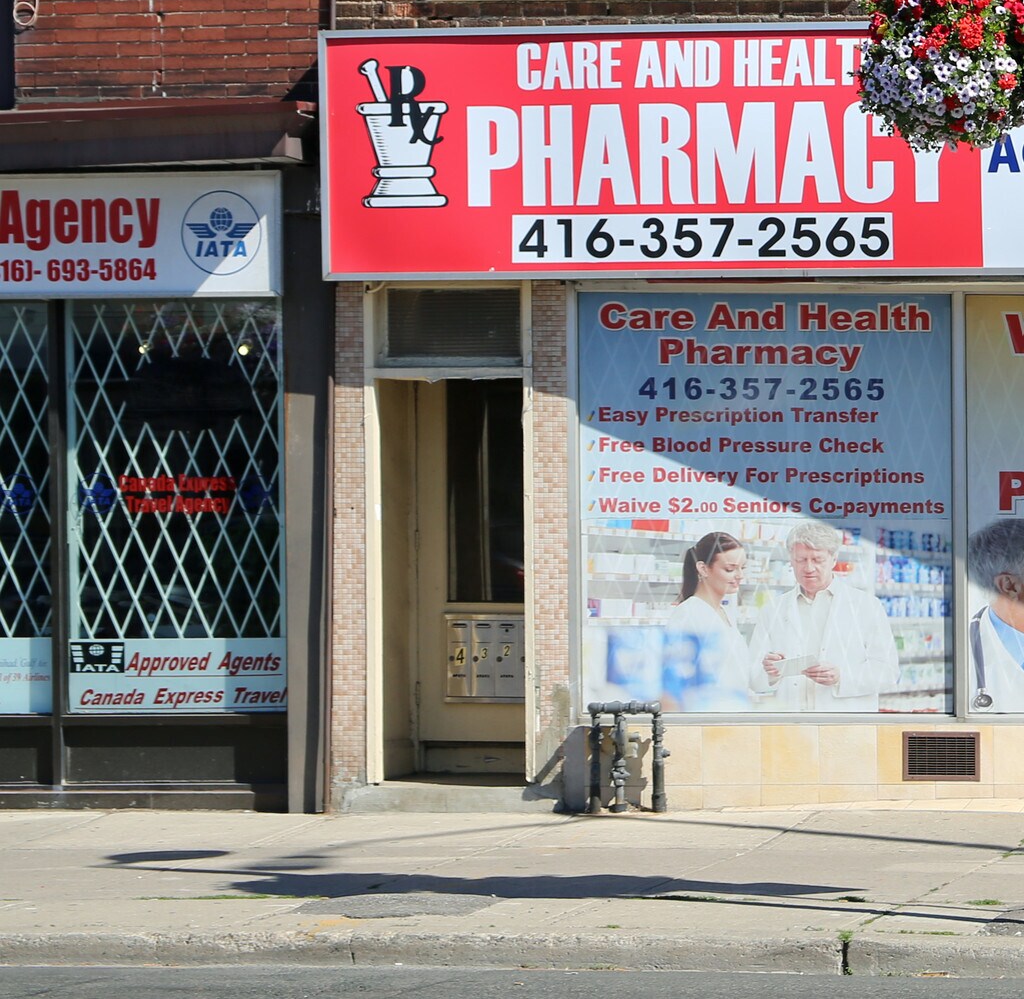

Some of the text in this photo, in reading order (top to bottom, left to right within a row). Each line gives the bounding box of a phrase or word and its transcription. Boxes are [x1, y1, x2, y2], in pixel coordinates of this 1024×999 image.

[517, 38, 871, 91] CARE AND HEALT
[466, 100, 944, 208] PHARMACY
[0, 190, 160, 252] Agency
[195, 240, 247, 258] IATA
[517, 215, 890, 260] 416-357-2565
[47, 258, 157, 282] 693-5864
[599, 302, 933, 331] Care And Health
[658, 338, 863, 372] Pharmacy
[638, 376, 885, 401] 416-357-2565
[598, 406, 879, 426] Easy Prescription Transfer
[598, 436, 885, 454] Free Blood Pressure Check
[119, 474, 237, 493] Canada Express
[598, 466, 925, 487] Free Delivery For Prescriptions
[125, 495, 173, 513] Travel
[176, 495, 230, 515] Agency
[598, 496, 945, 518] Waive $2.00 Seniors Co-payments
[126, 651, 281, 676] Approved Agents
[456, 645, 511, 664] 4 3 2
[75, 663, 120, 672] IATA
[80, 686, 288, 709] Canada Express Travel
